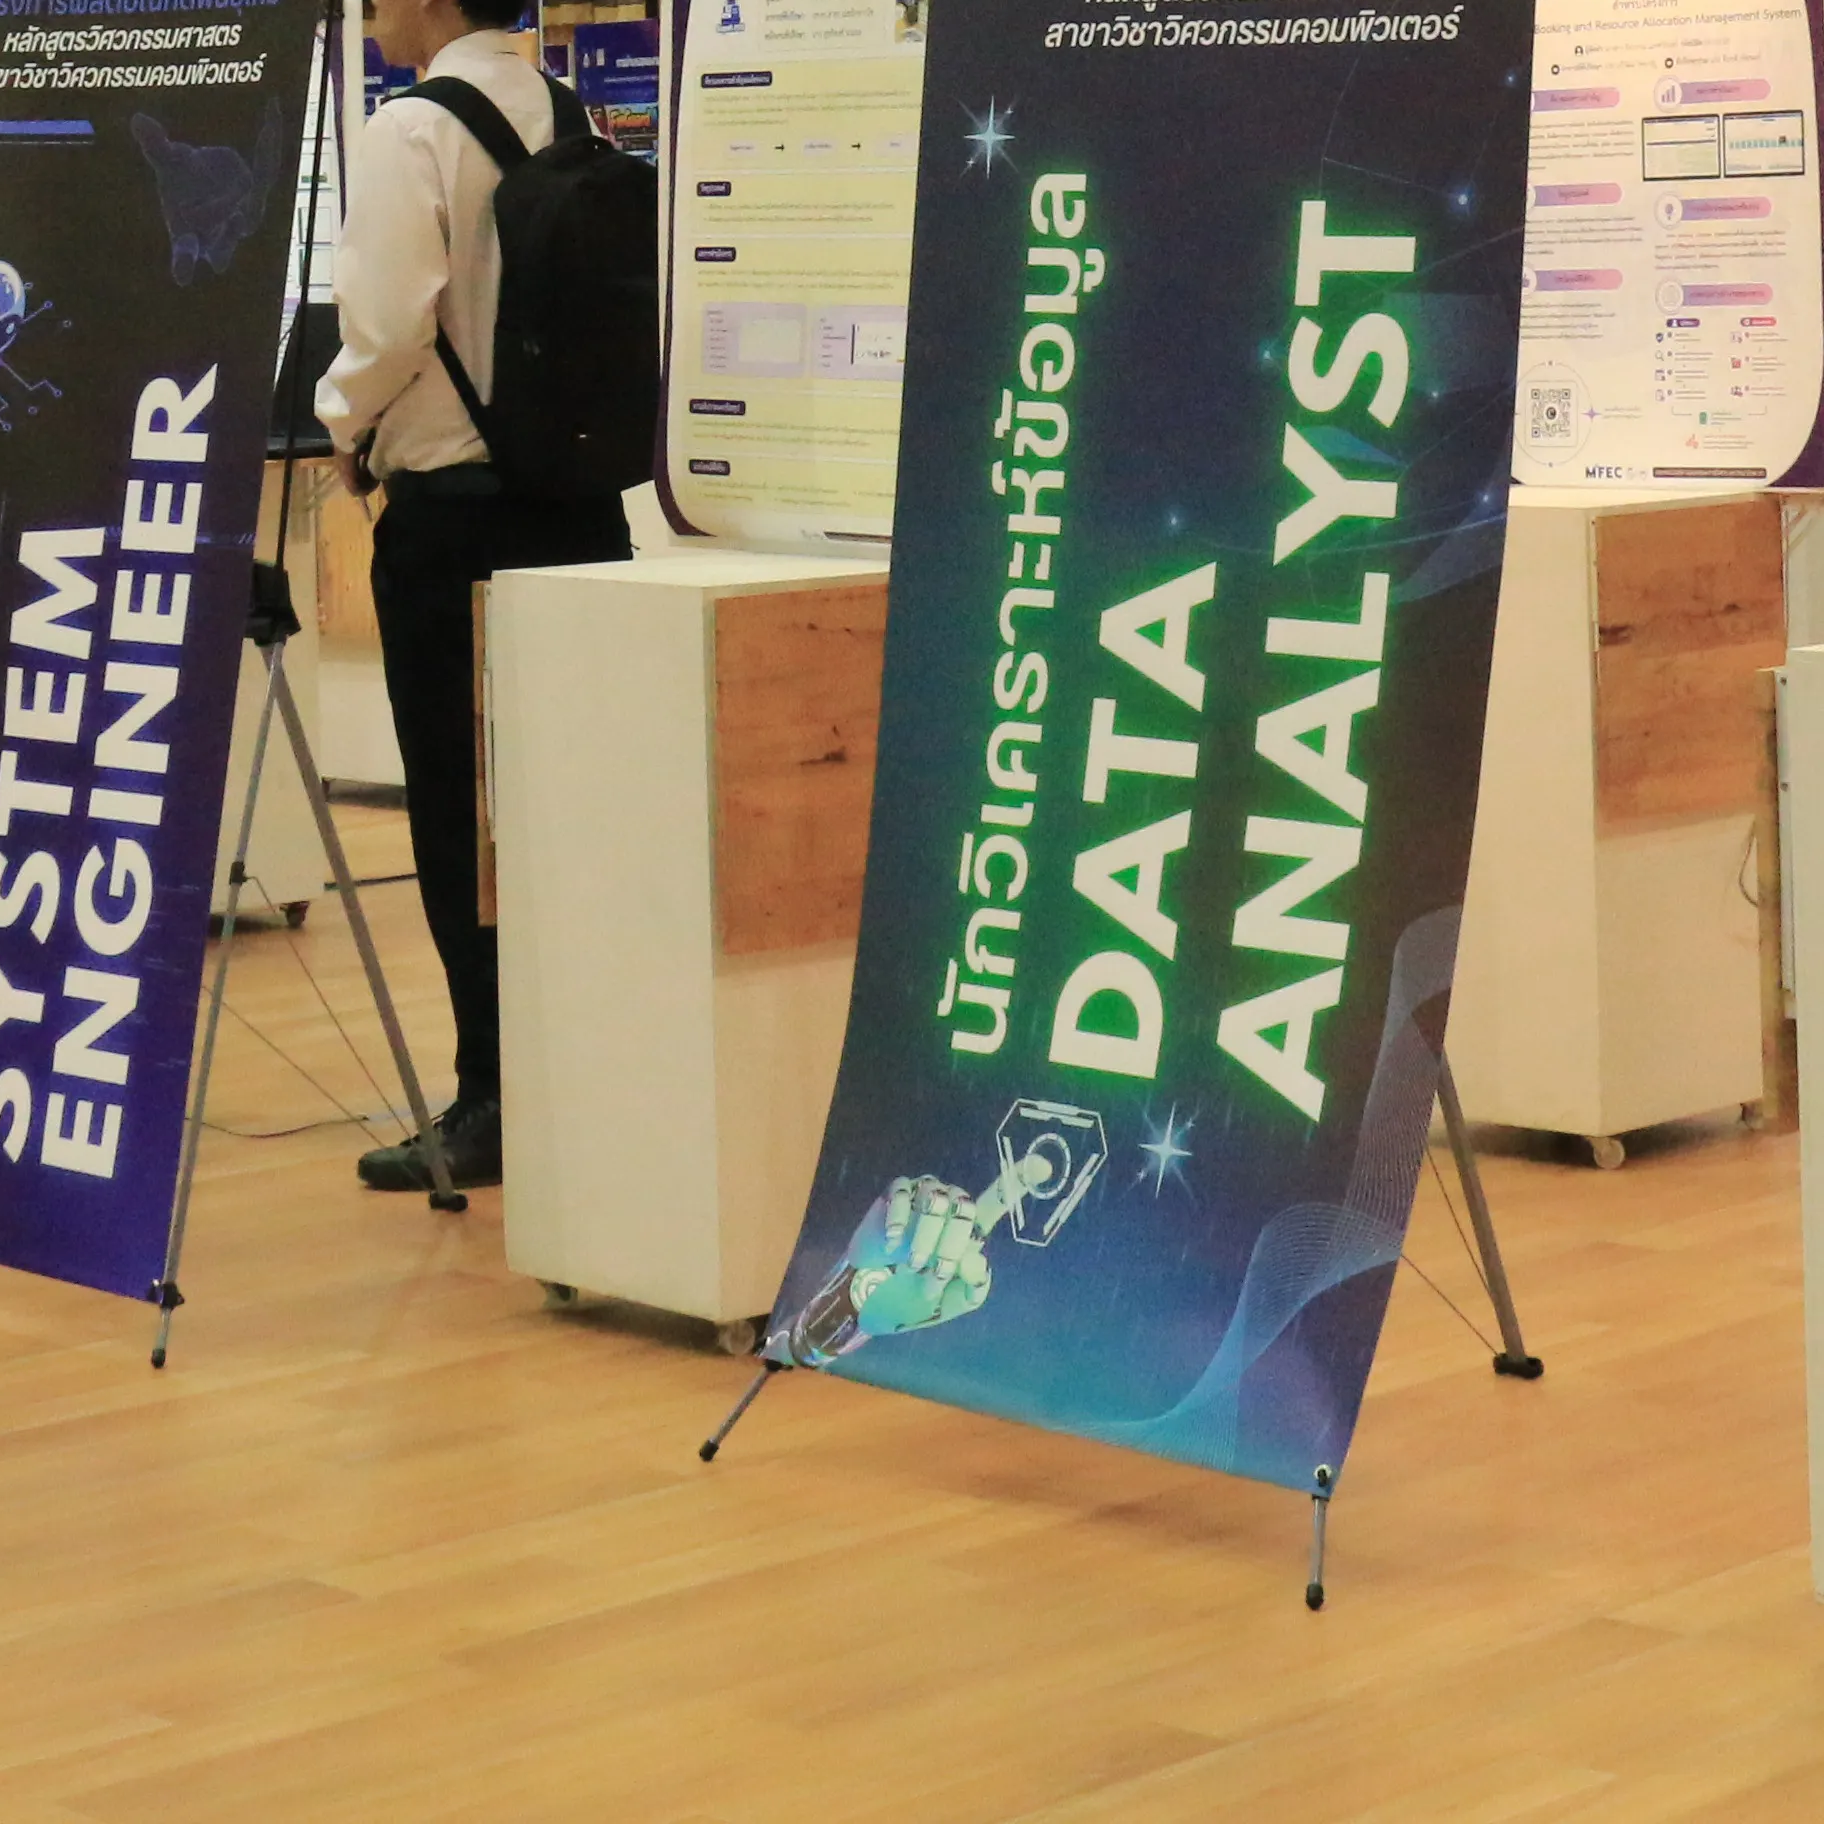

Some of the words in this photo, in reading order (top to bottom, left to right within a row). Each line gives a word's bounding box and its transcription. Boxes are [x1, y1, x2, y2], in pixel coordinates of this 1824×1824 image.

[1044, 5, 1464, 49] สาขาวิชาวิศวกรรมคอมพิวเตอร์
[1595, 18, 1639, 31] Resource
[1642, 14, 1692, 28] Allocation
[1696, 10, 1761, 26] Management
[1764, 7, 1802, 22] System
[936, 172, 1107, 1056] นักวิเคราะห์ข้อมูล
[1215, 199, 1418, 1123] ANALYST
[1585, 465, 1623, 479] MFEC
[41, 363, 217, 1179] ENGINEER
[1048, 559, 1217, 1080] DATA
